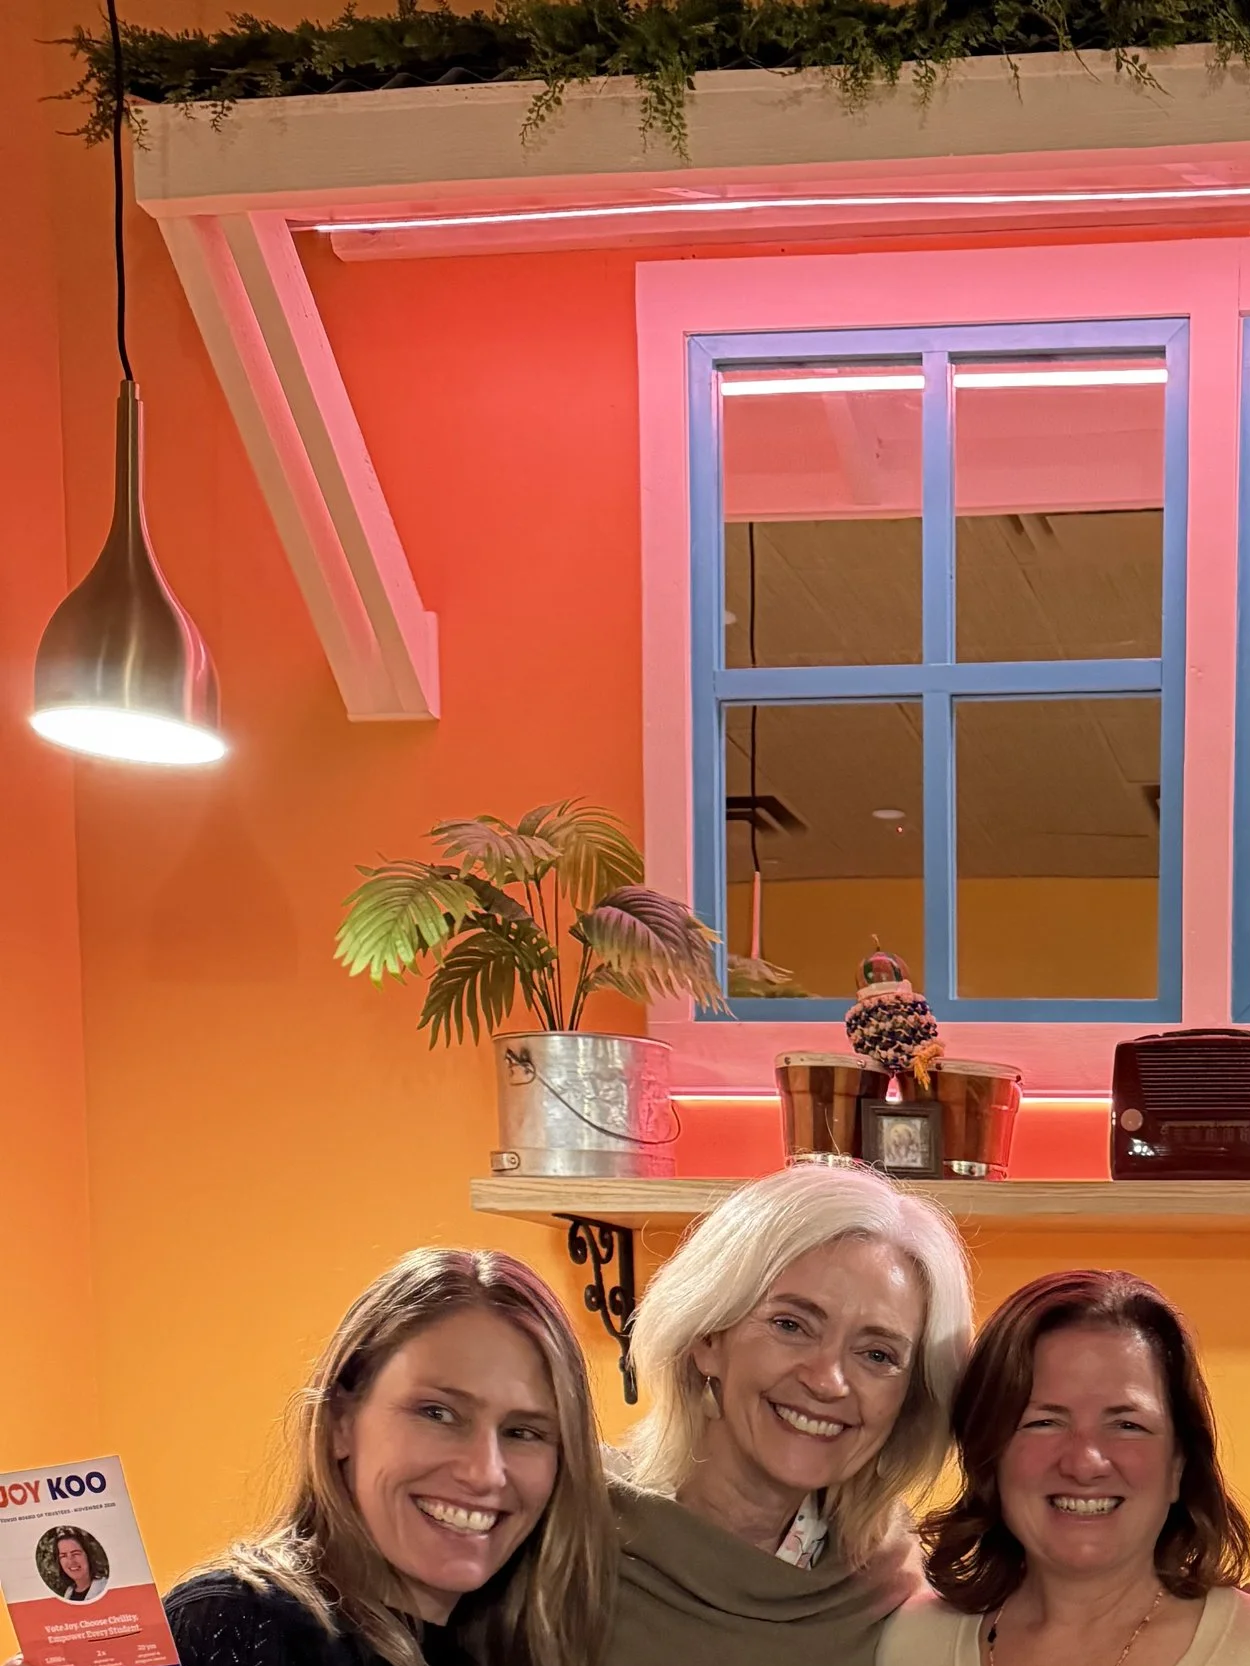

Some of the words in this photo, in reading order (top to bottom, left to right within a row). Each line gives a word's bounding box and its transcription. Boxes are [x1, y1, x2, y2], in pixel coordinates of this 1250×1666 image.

[0, 1481, 40, 1508] JOY
[47, 1472, 106, 1499] KOO
[45, 1625, 63, 1633] Vote
[63, 1623, 78, 1631] Joy.
[79, 1617, 107, 1628] Choose
[108, 1614, 138, 1624] Civility.
[48, 1633, 85, 1643] Empower
[86, 1629, 108, 1638] Every
[108, 1624, 142, 1635] Student.
